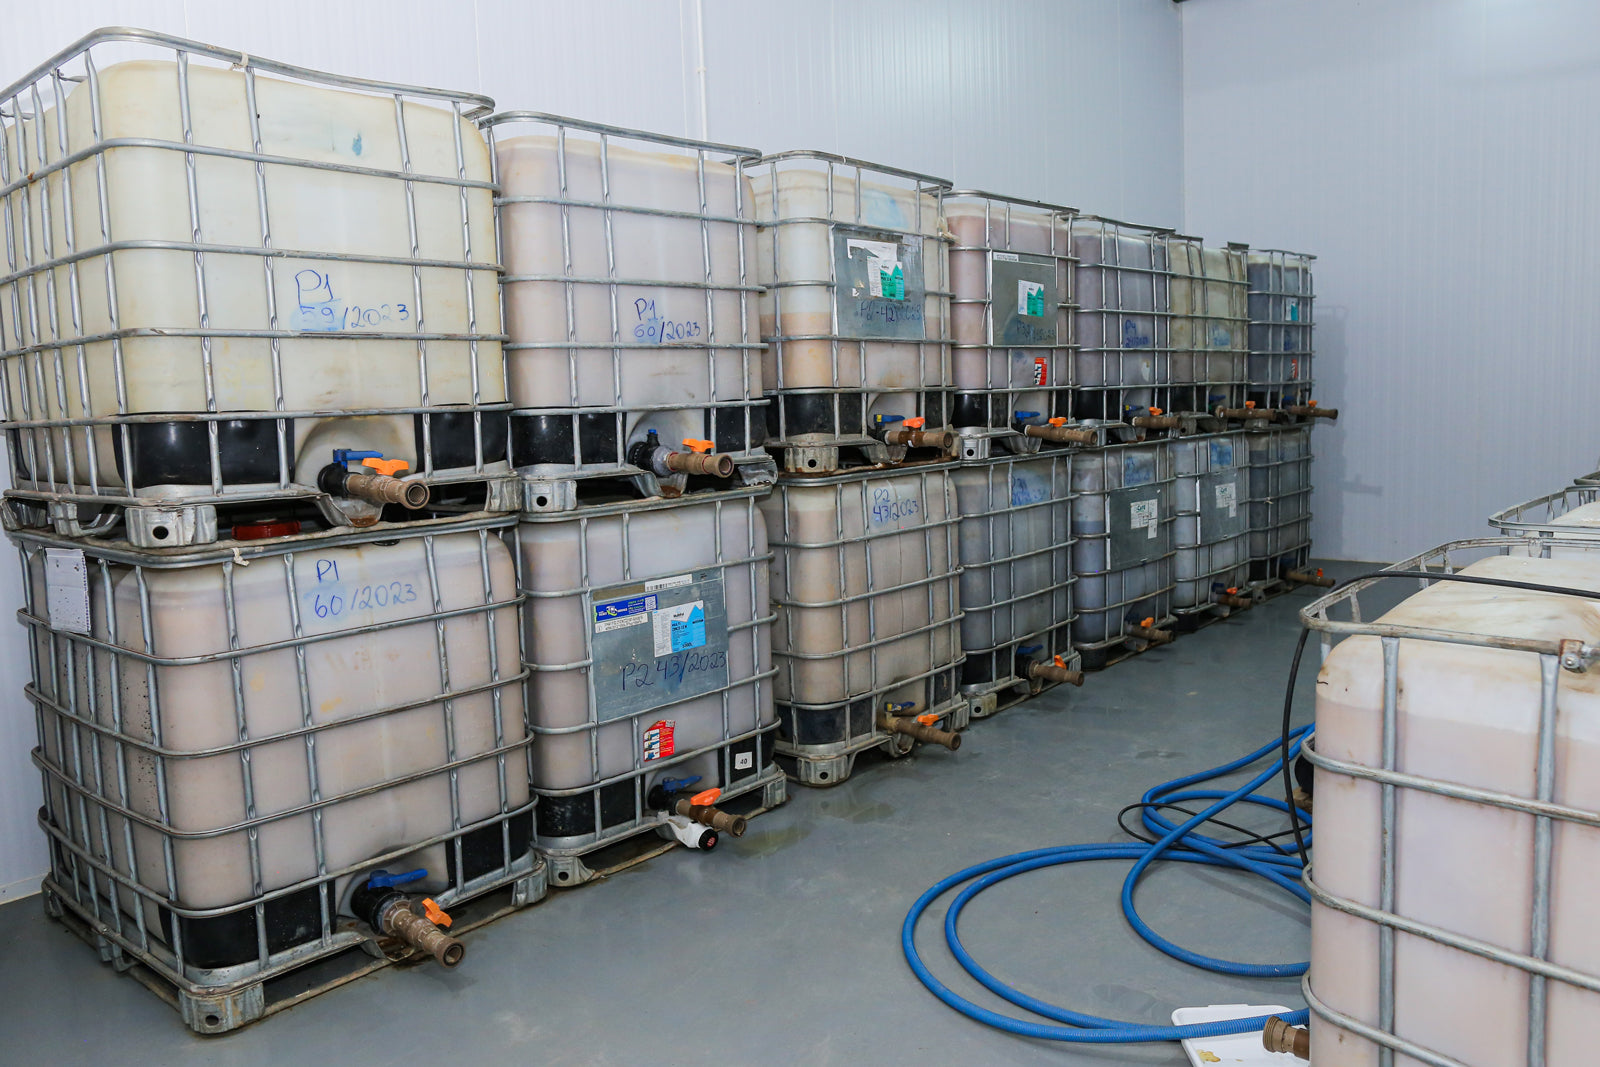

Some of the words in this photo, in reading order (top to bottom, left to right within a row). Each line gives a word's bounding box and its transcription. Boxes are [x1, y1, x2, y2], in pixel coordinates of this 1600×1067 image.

[634, 297, 659, 321] P1
[633, 320, 701, 344] 60/2023
[873, 487, 890, 505] P2
[872, 498, 920, 523] 43/2023
[314, 581, 418, 618] 60/2023
[622, 662, 654, 692] P2
[656, 650, 728, 684] 43/2023
